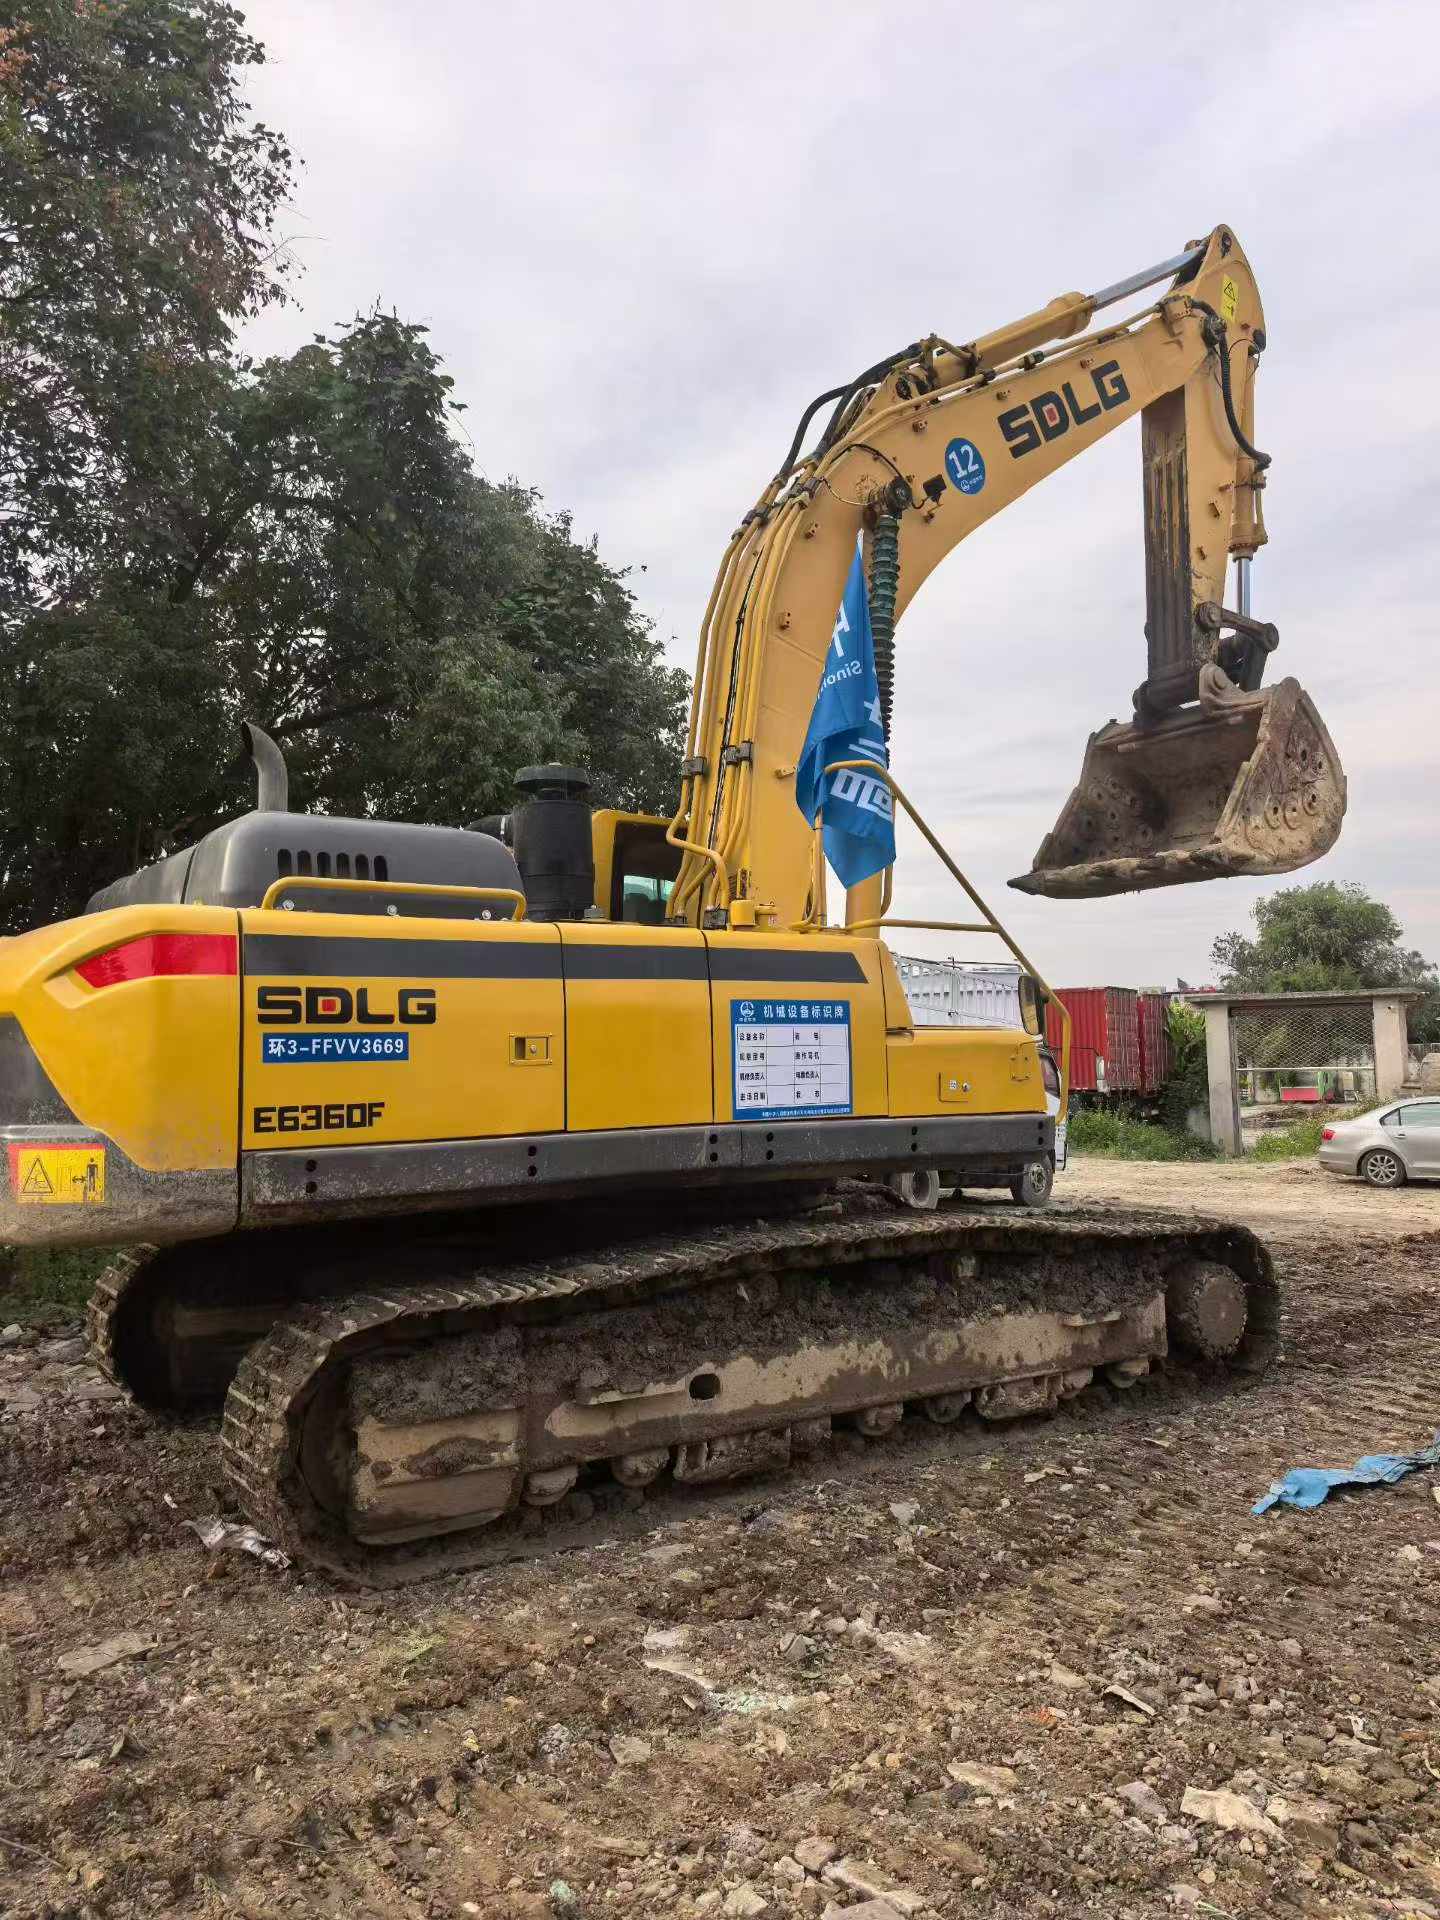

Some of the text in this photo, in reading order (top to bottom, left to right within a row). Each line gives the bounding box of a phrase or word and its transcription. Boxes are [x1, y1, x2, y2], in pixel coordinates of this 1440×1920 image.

[998, 360, 1130, 459] SDLG
[948, 444, 979, 478] 12
[257, 986, 437, 1024] SDLG
[763, 1005, 843, 1018] 机械设备标识牌
[268, 1038, 404, 1057] 环3-FFVV3669
[253, 1102, 385, 1133] E6360F
